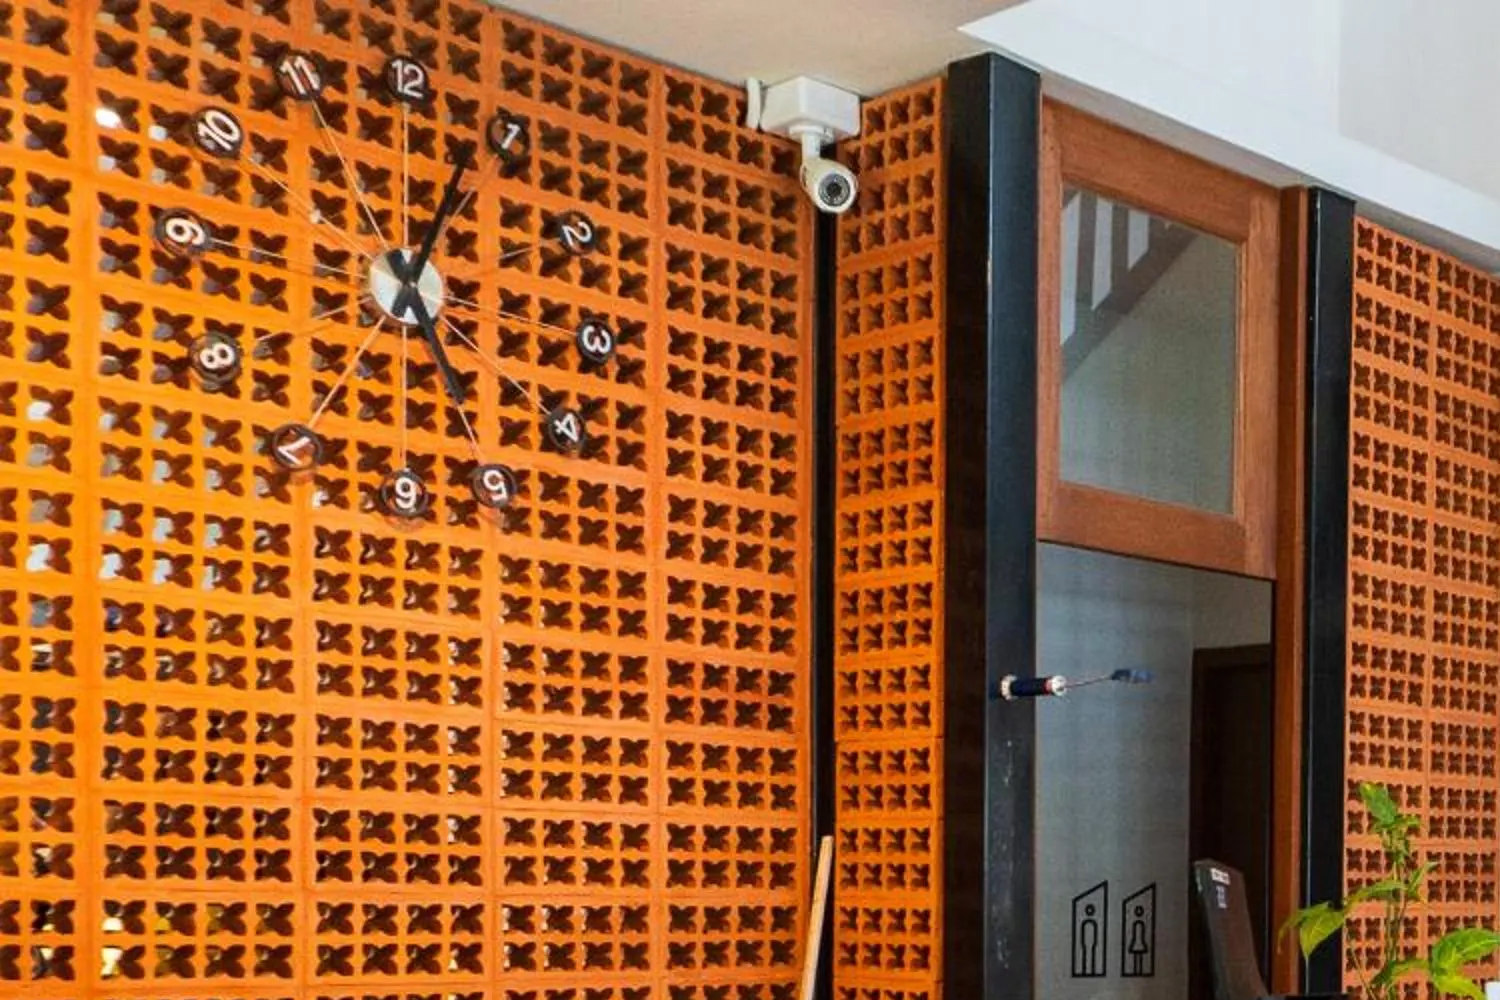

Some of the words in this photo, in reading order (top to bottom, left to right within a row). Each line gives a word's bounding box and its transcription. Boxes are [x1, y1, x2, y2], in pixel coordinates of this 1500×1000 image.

[280, 56, 321, 96] 11
[391, 59, 424, 98] 12
[197, 109, 241, 151] 10
[502, 122, 520, 150] 1
[561, 222, 592, 252] 2
[200, 343, 236, 370] 8
[583, 326, 612, 356] 3
[552, 413, 581, 442] 4
[277, 431, 316, 467] 7
[483, 470, 508, 502] 5
